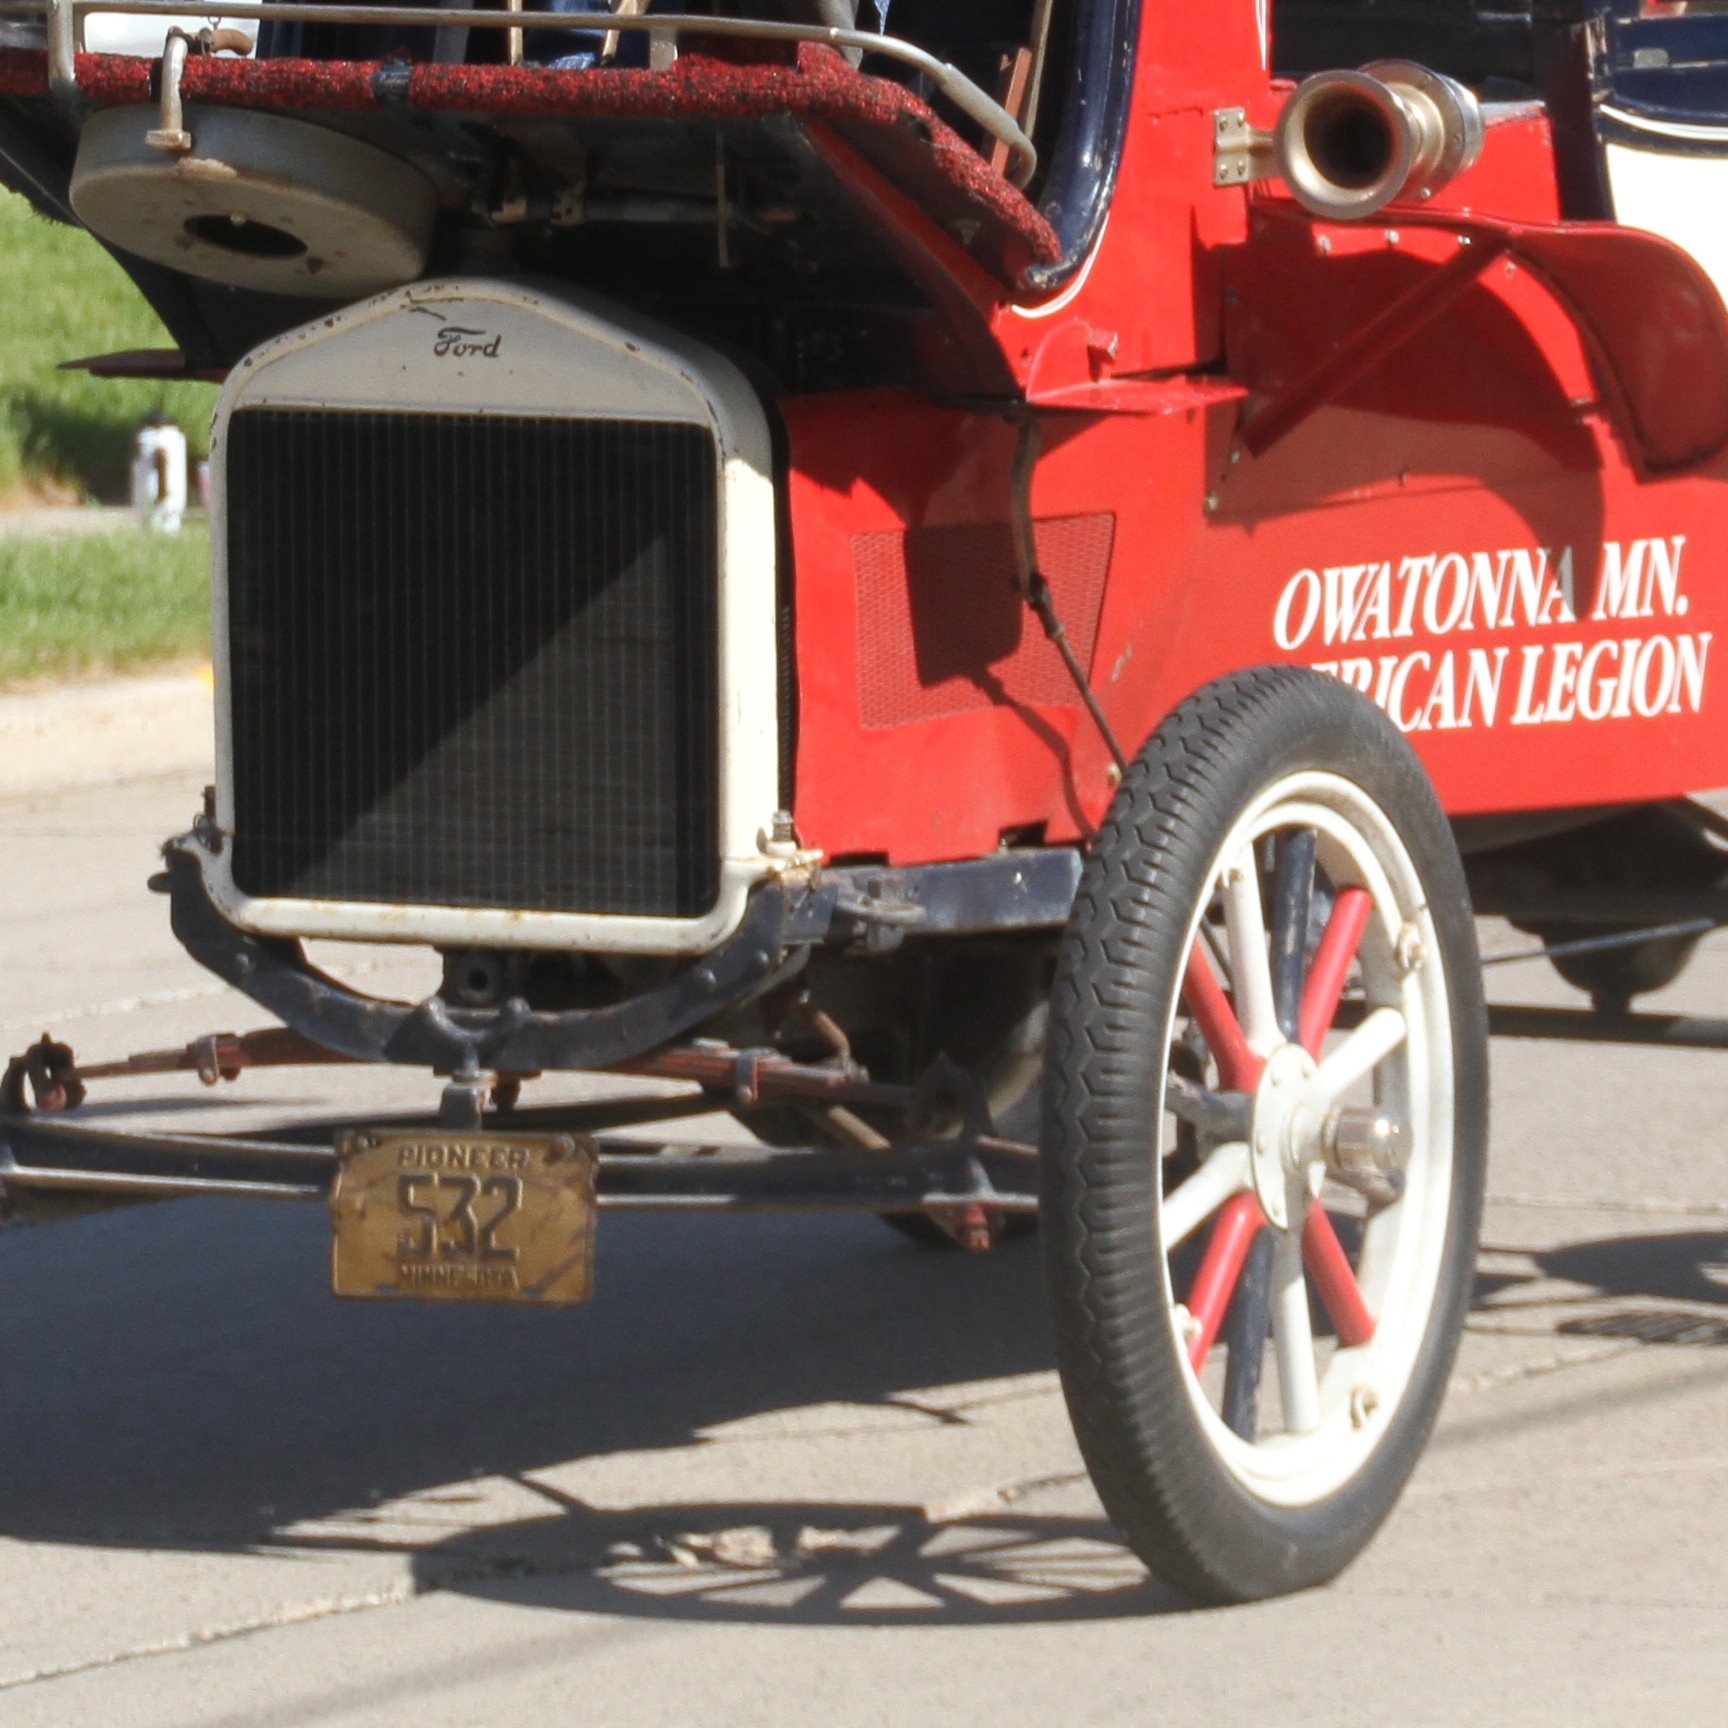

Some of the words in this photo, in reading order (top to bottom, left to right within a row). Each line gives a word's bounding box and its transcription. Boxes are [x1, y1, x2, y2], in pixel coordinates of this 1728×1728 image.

[434, 327, 502, 358] Ford
[1273, 543, 1578, 651] OWATONNA
[1592, 535, 1689, 621] MN.
[1311, 647, 1509, 733] RICAN
[1511, 632, 1712, 727] LEGION
[398, 1143, 531, 1170] PIONEER
[397, 1170, 524, 1261] 532
